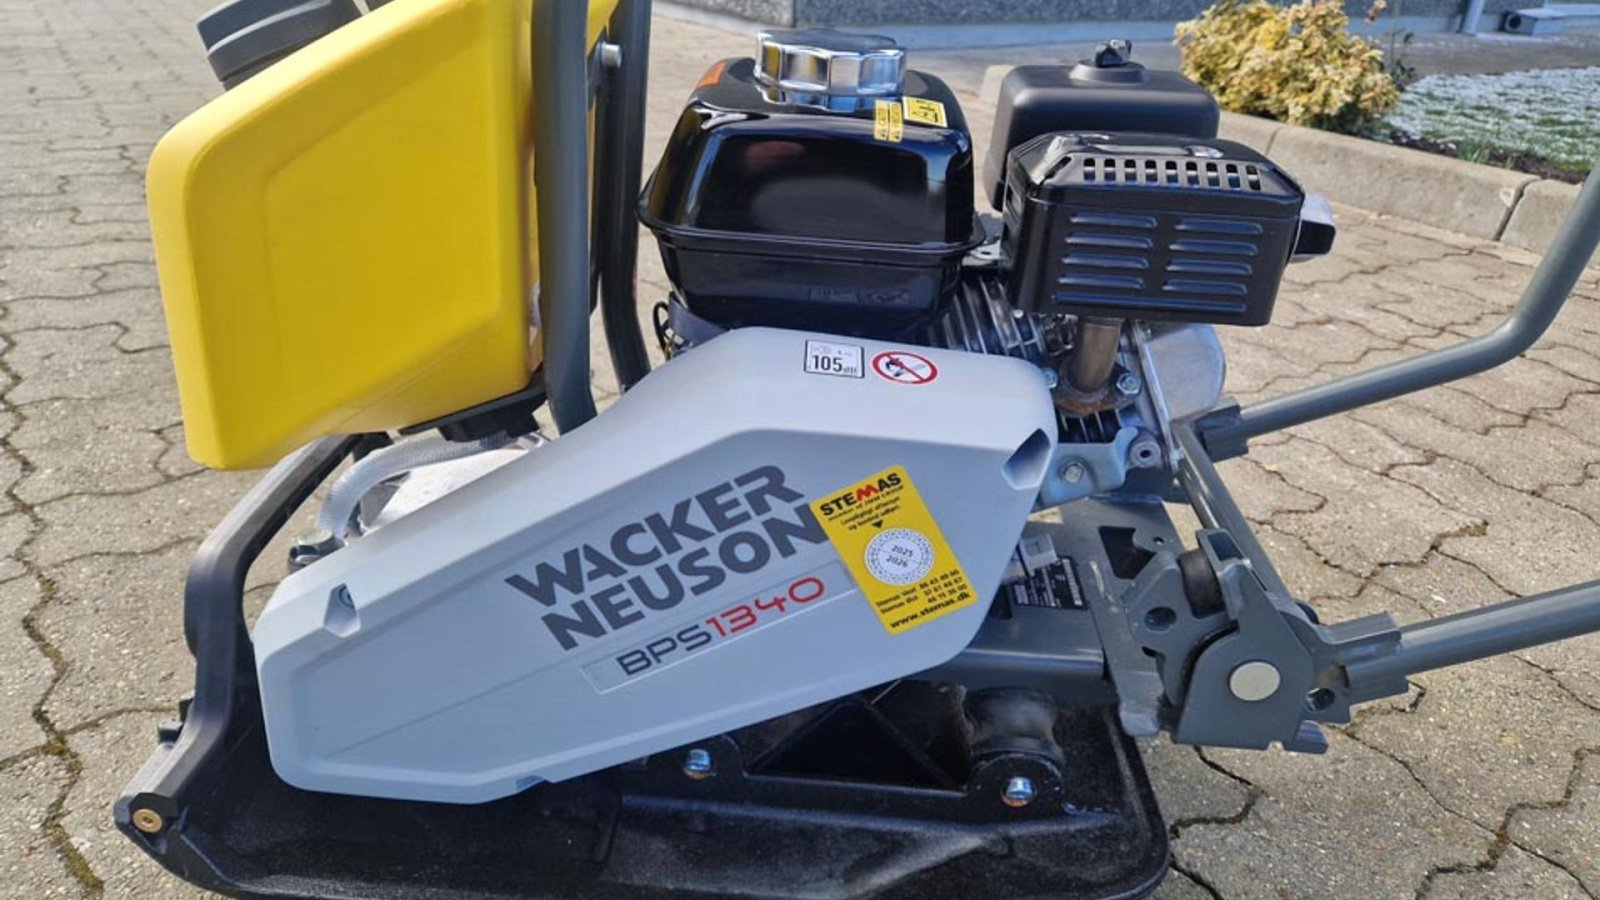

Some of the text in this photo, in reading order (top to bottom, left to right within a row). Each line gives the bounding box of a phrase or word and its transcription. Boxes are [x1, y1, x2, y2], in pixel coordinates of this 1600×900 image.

[820, 473, 901, 515] STEMAS
[504, 465, 804, 607] WACKER
[891, 545, 913, 557] 2025
[541, 503, 829, 651] NEUSON
[886, 555, 908, 567] 2026
[616, 576, 825, 676] BPS1340
[889, 591, 970, 628] www.stemas.dk
